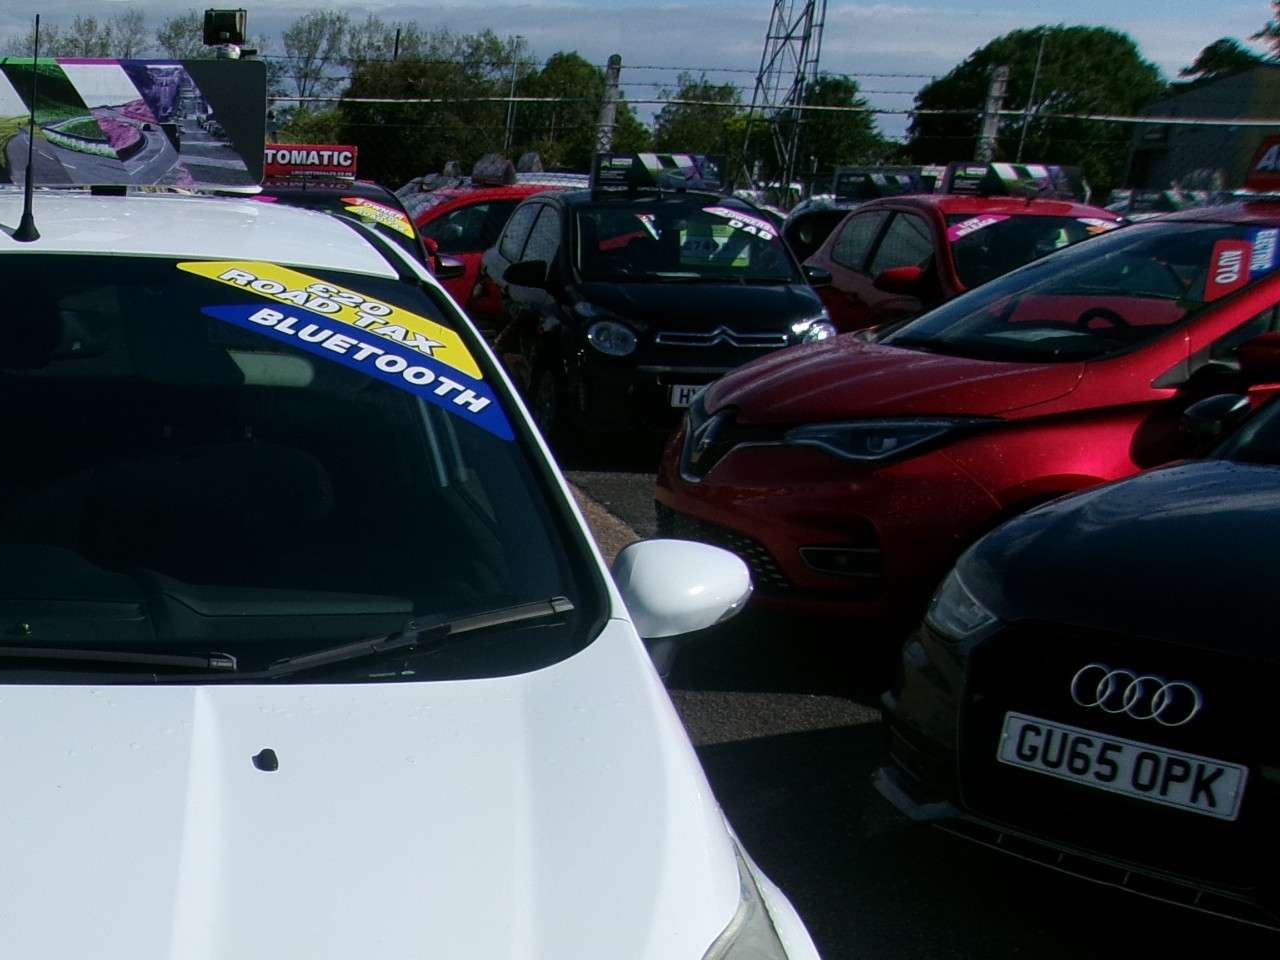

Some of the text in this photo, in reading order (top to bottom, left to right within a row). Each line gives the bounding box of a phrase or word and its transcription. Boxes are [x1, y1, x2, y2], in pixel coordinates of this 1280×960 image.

[727, 219, 773, 241] DAB
[1214, 250, 1243, 284] AUTO
[219, 267, 447, 358] ROAD TAX
[305, 282, 393, 318] £20
[247, 307, 491, 413] BLUETOOTH
[1015, 723, 1225, 809] GU65 OPK
